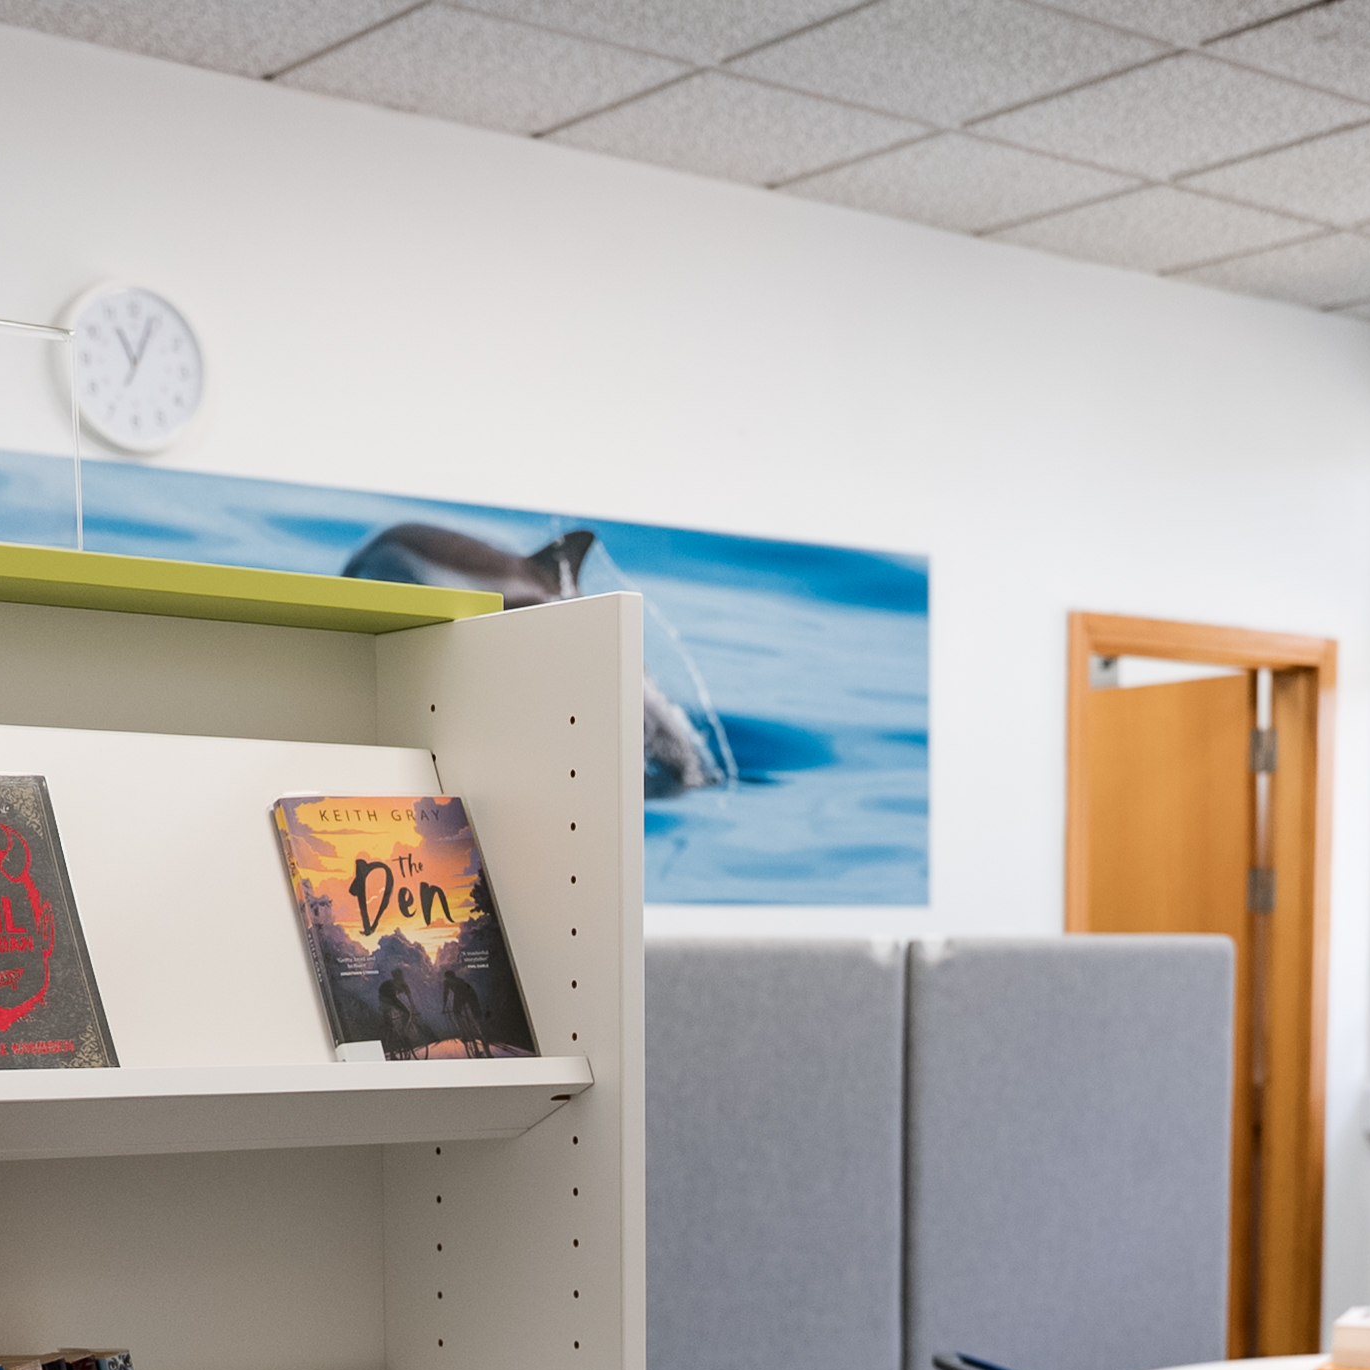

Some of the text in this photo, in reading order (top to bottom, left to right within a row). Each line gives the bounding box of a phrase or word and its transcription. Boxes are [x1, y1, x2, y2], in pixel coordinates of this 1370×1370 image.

[319, 809, 441, 822] KEITH GRAY
[392, 853, 424, 878] The
[349, 859, 455, 936] Den
